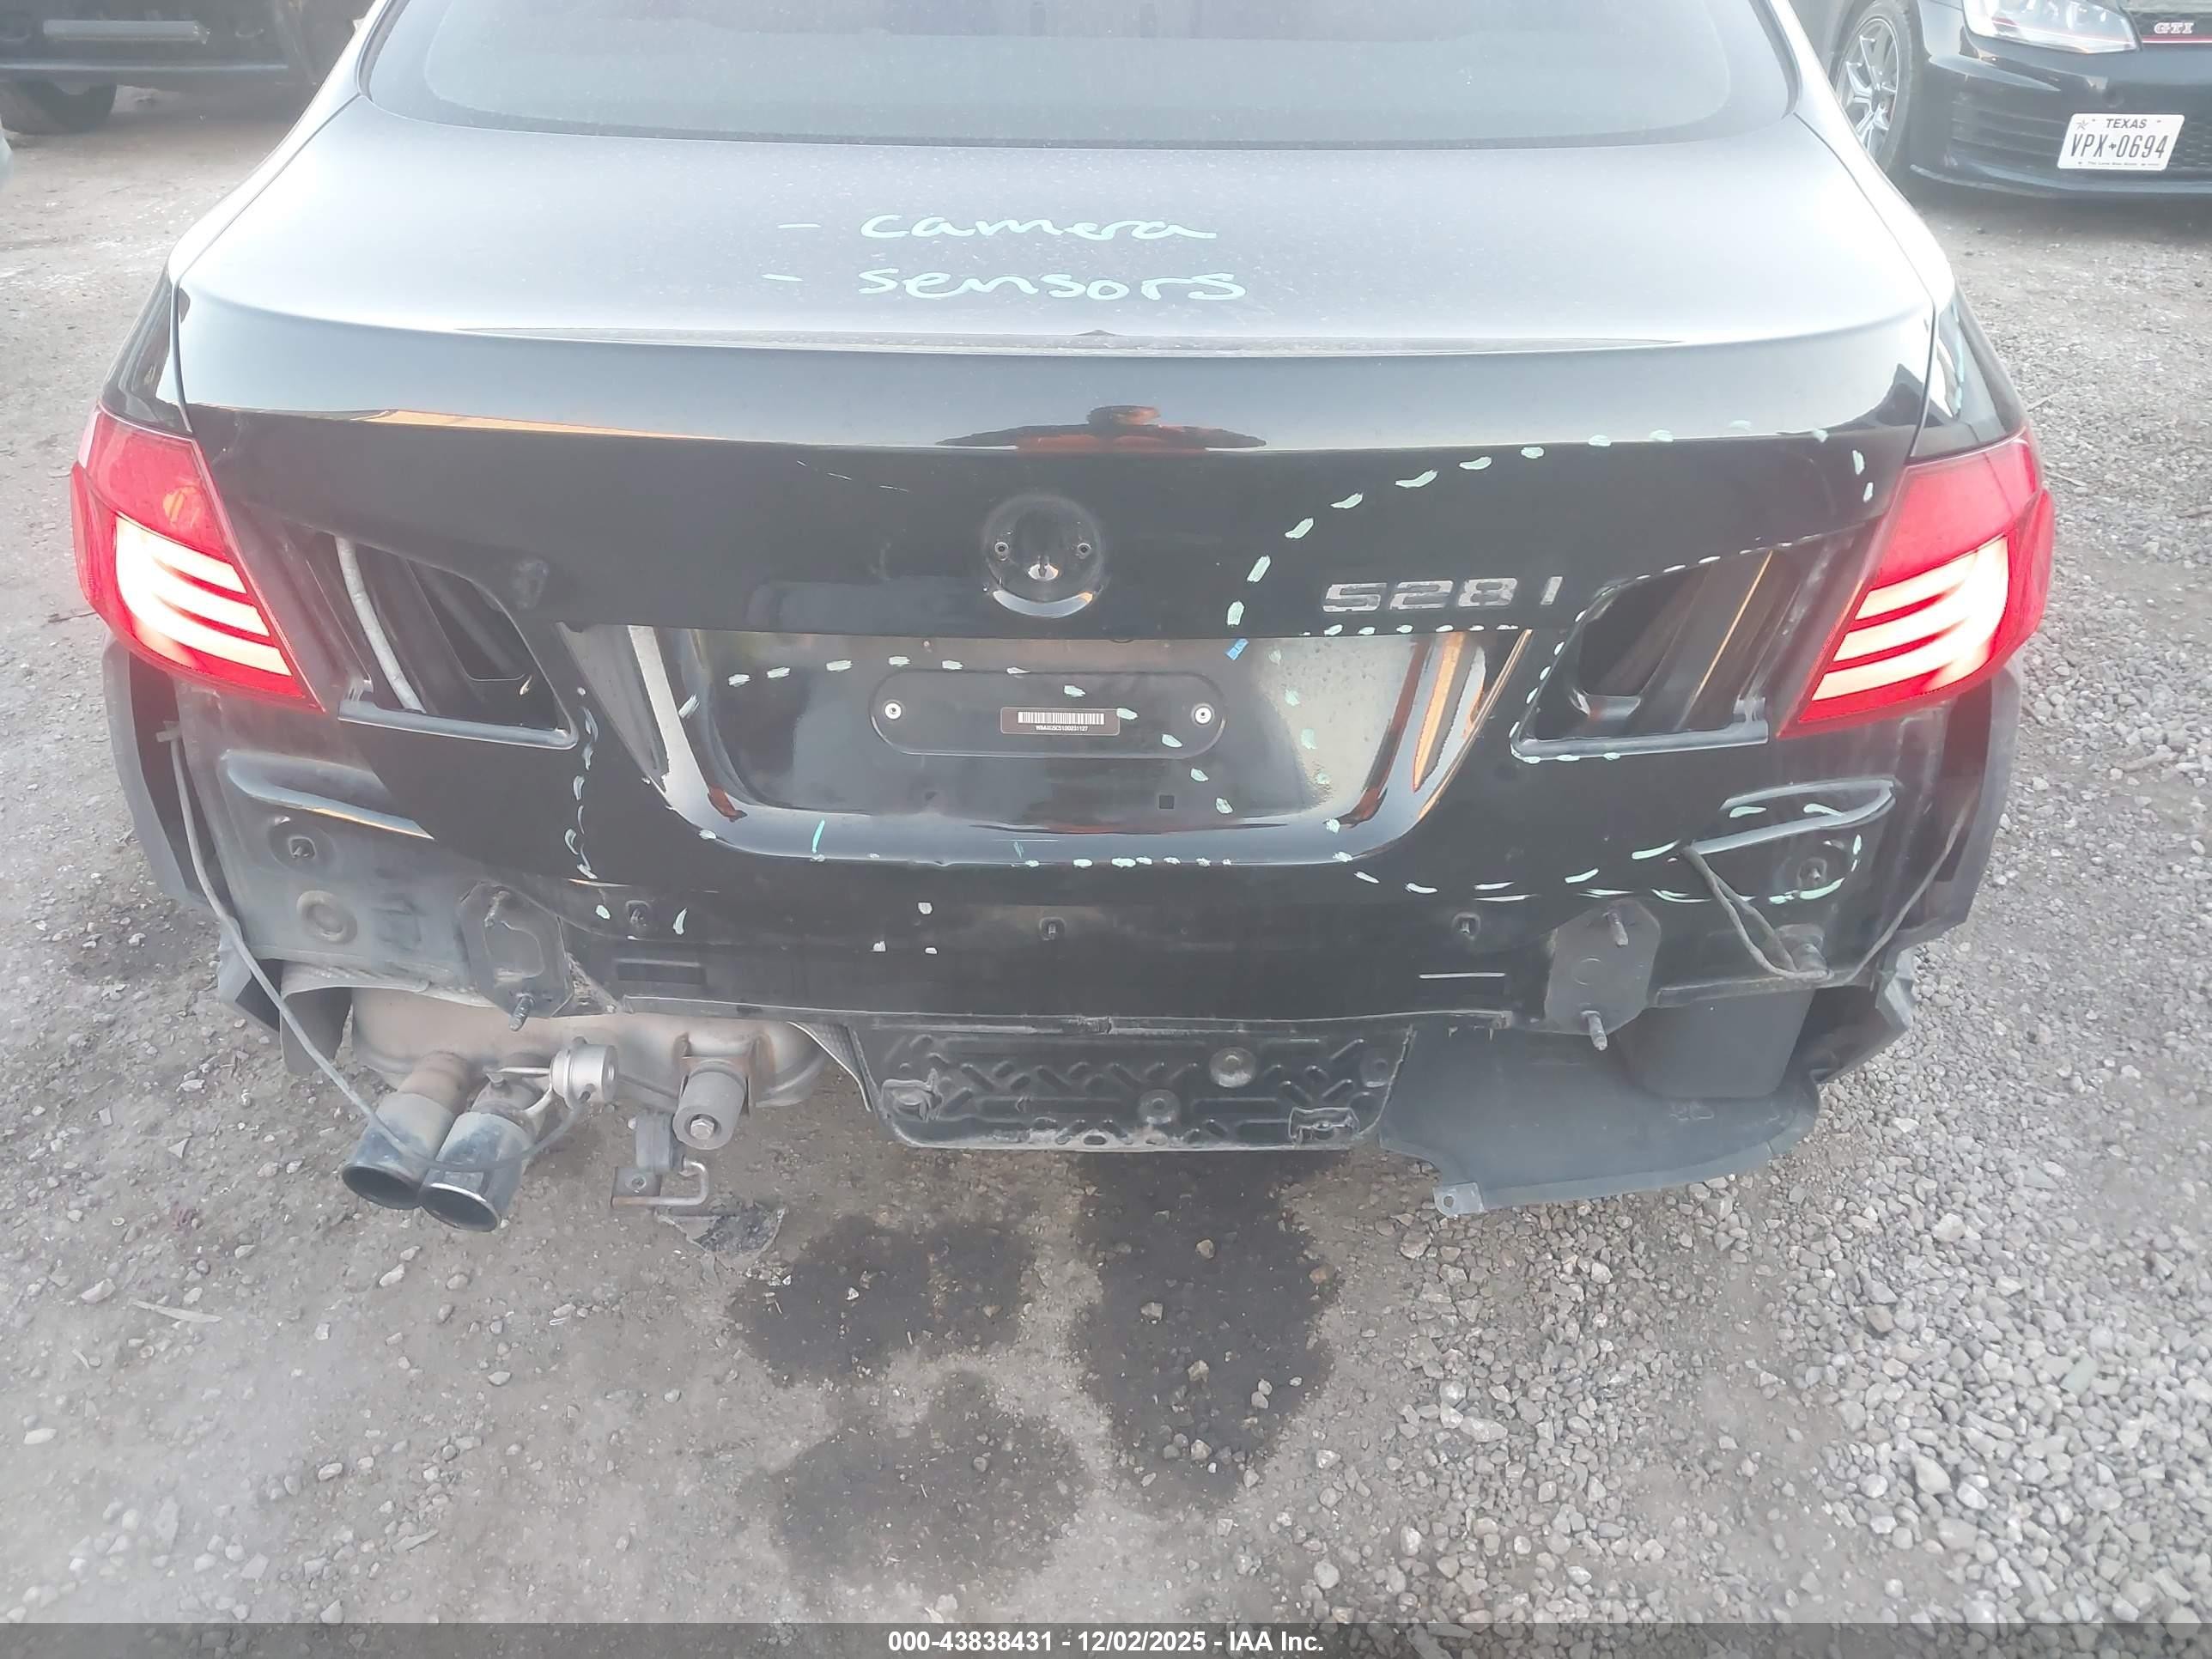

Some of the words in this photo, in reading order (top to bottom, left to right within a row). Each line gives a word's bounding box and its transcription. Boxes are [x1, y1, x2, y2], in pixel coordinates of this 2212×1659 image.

[2154, 21, 2194, 34] GTI
[2106, 118, 2148, 129] TEXAS
[2070, 133, 2109, 158] VPX
[2116, 134, 2169, 159] 0694
[860, 214, 1218, 240] camera
[858, 267, 1248, 301] sensors
